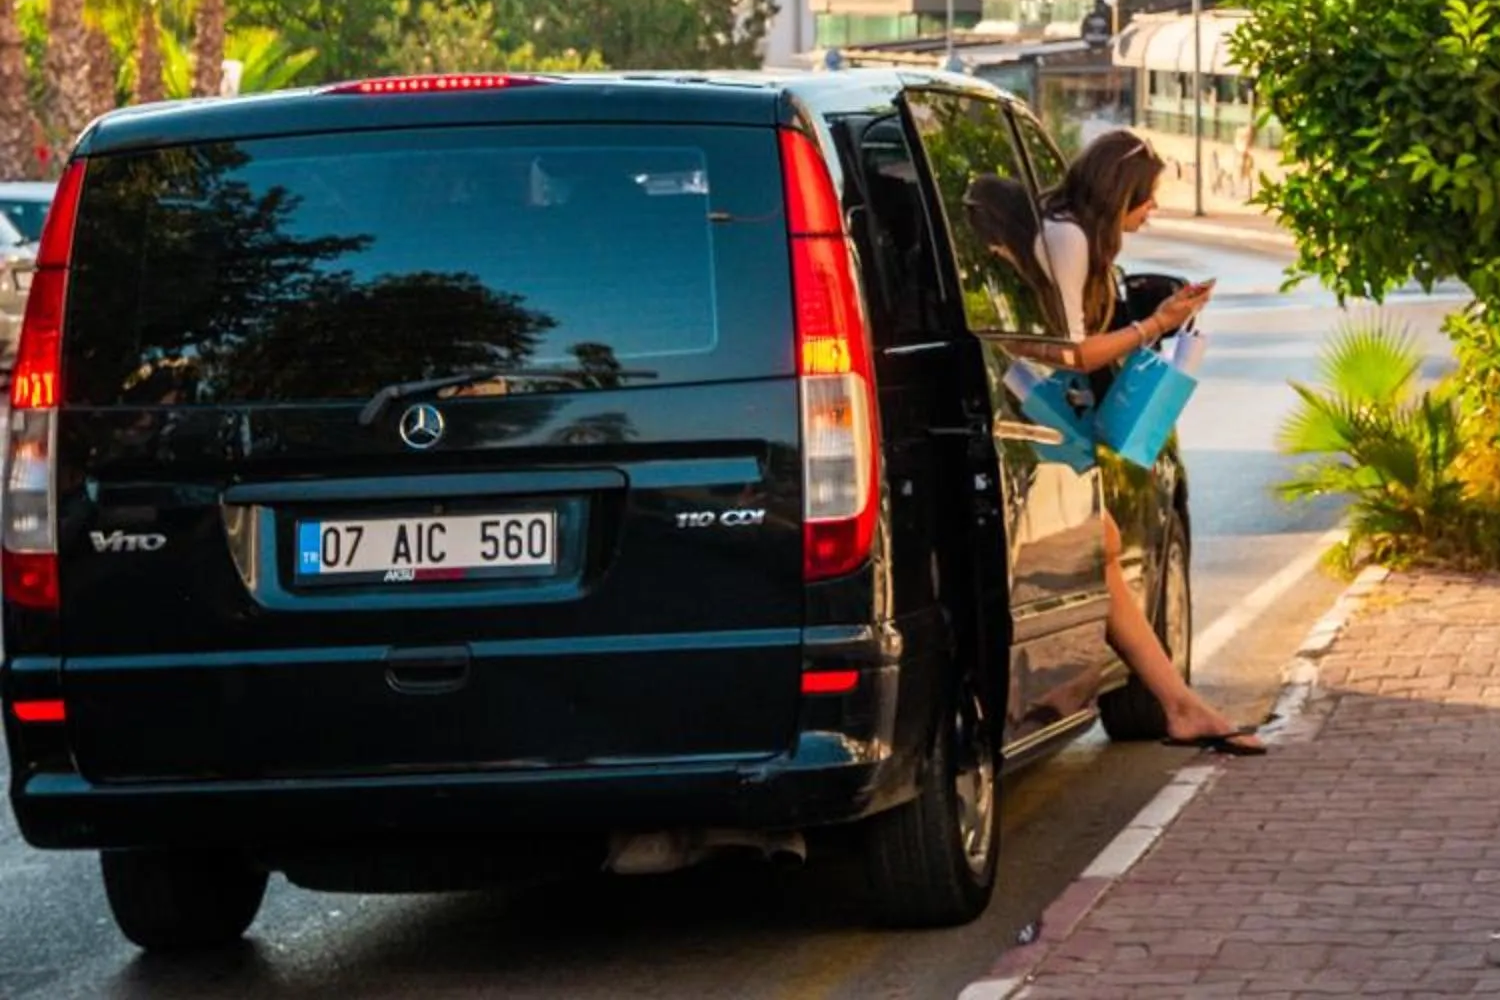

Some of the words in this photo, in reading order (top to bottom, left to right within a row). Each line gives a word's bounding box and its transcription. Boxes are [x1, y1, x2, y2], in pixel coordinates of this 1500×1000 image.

[675, 511, 716, 529] 110
[720, 508, 766, 527] CDI
[321, 526, 364, 567] 07
[392, 523, 447, 565] AIC
[480, 518, 548, 562] 560
